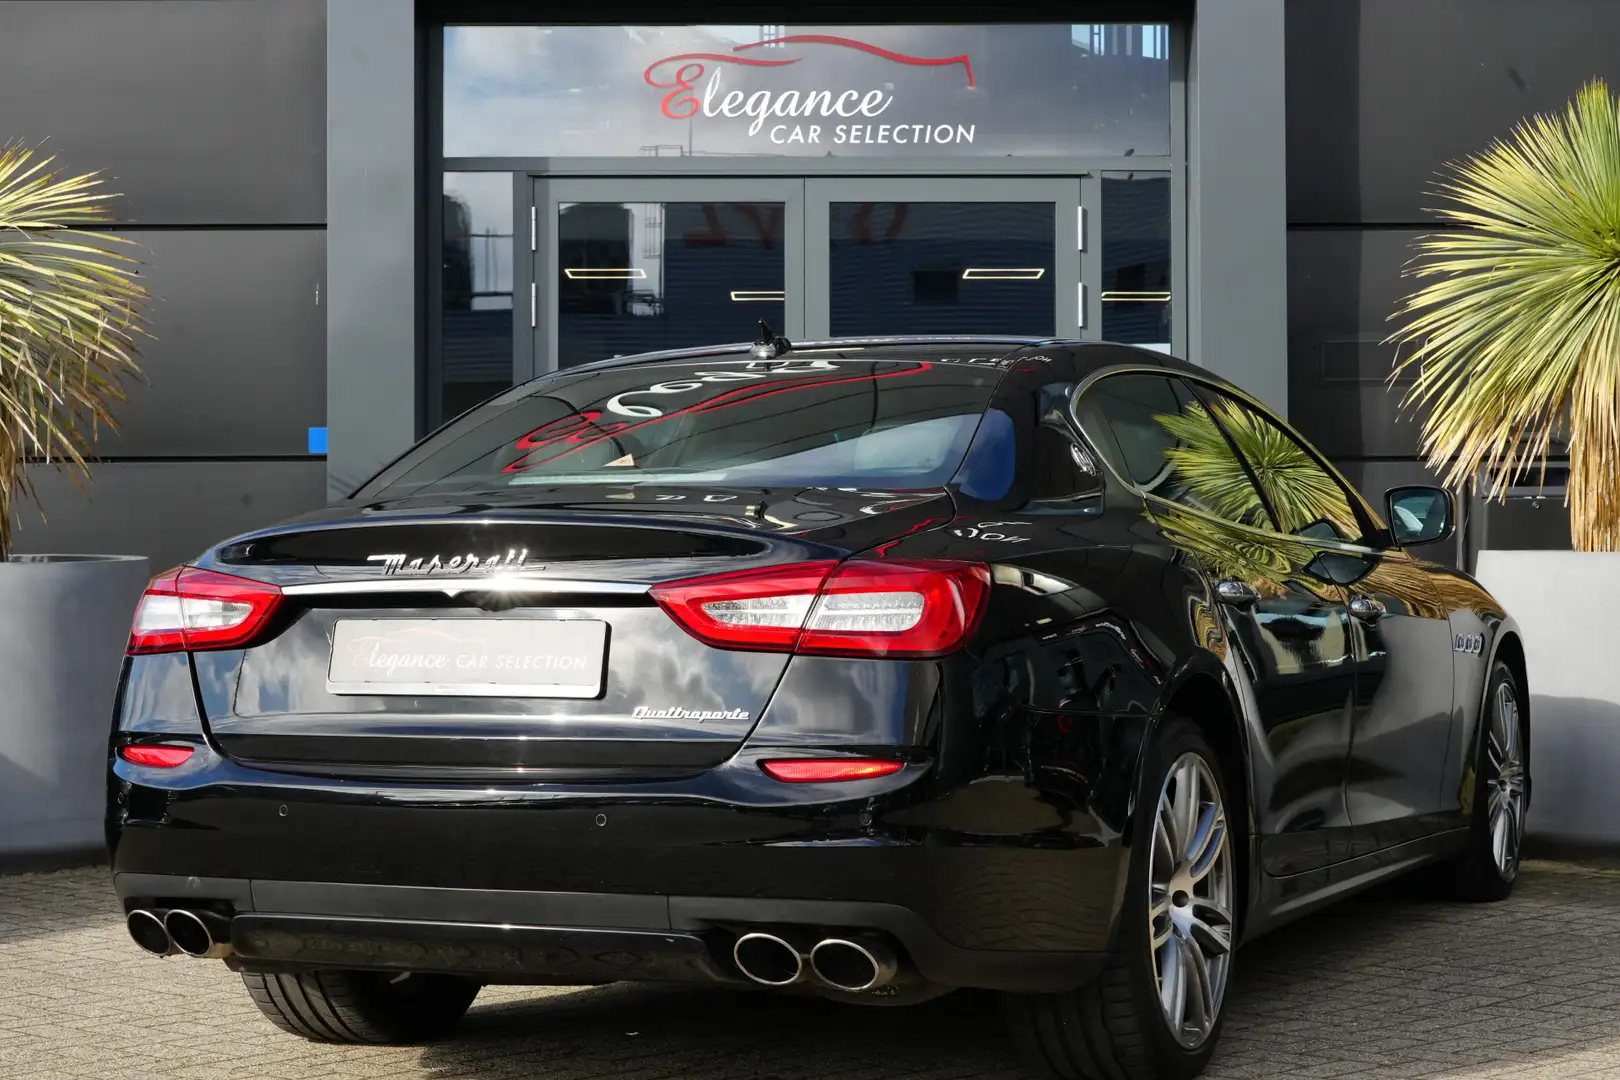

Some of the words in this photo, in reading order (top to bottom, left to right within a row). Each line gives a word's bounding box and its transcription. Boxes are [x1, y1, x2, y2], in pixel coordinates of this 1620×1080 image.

[644, 58, 893, 137] Elegance
[770, 124, 821, 144] CAR
[833, 124, 976, 144] SELECTION
[366, 547, 547, 576] Maserati
[349, 640, 452, 677] Elegance
[455, 654, 488, 670] CAR
[494, 654, 588, 671] SELECTION
[631, 705, 751, 724] Quattroporte
